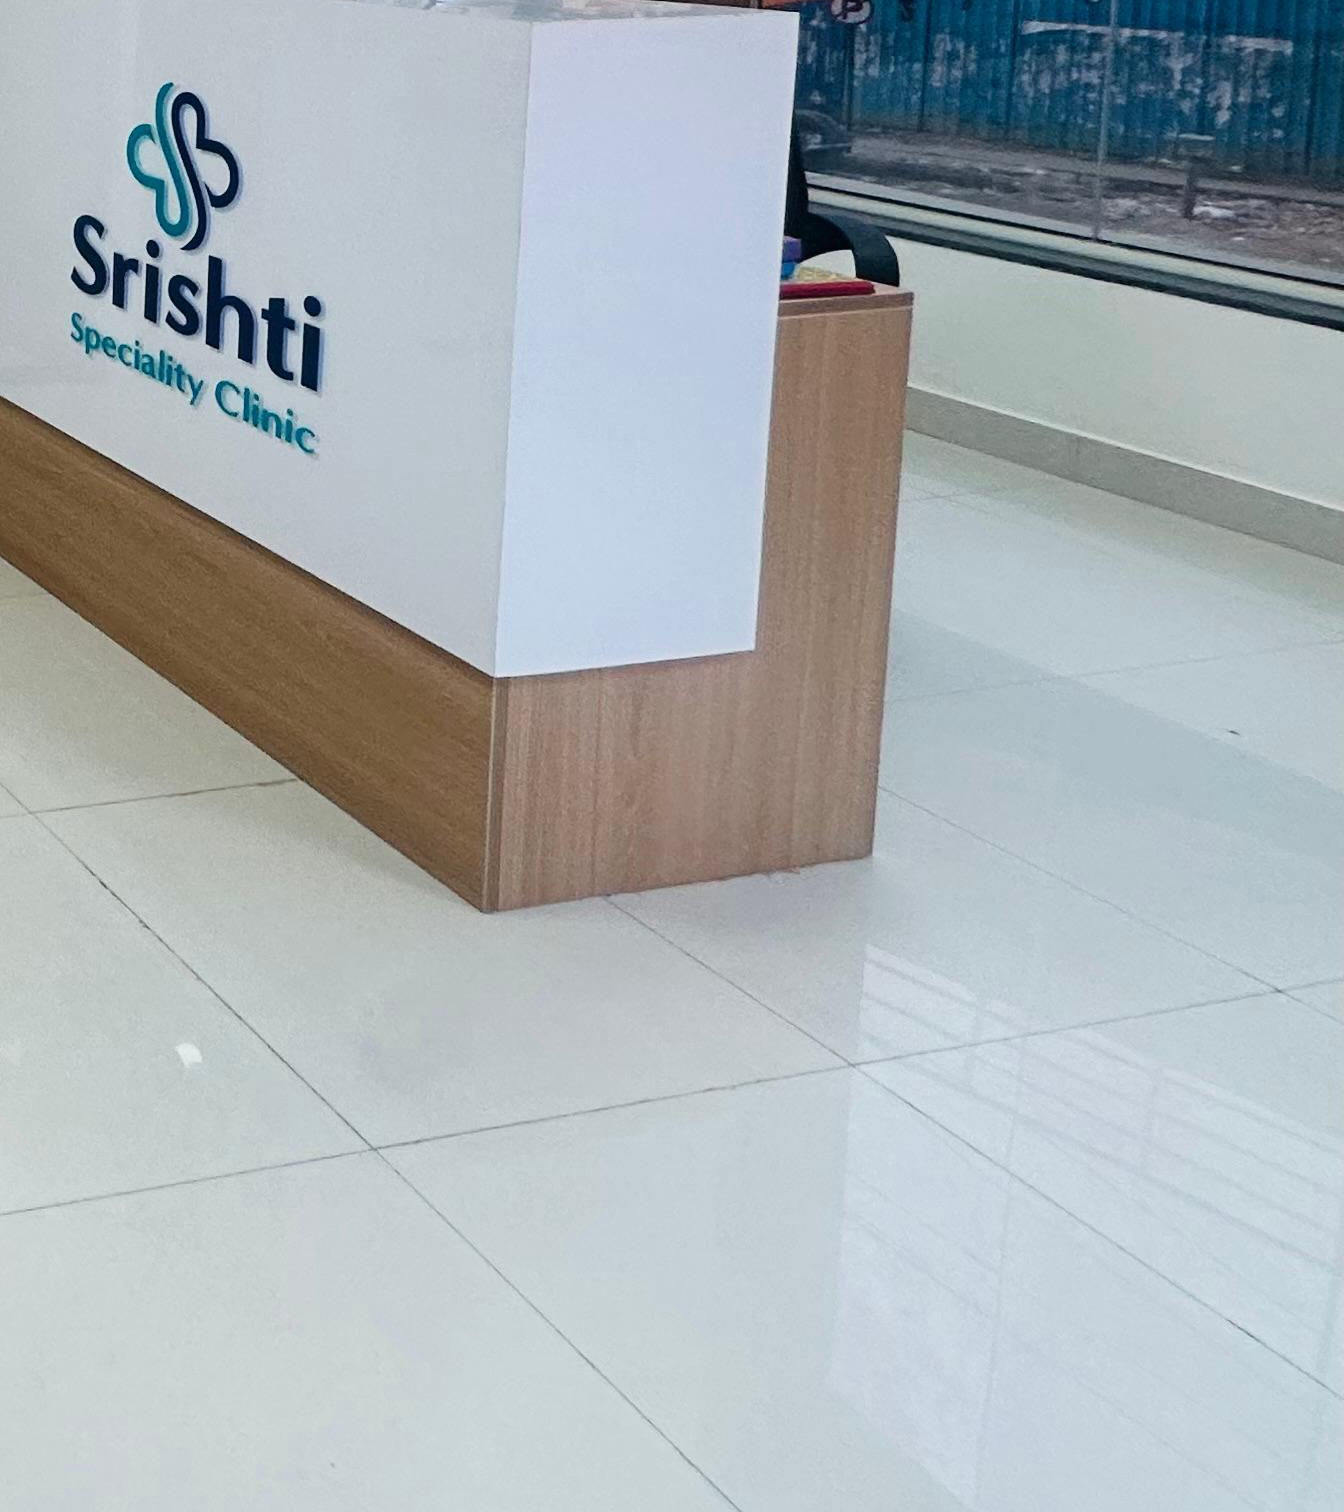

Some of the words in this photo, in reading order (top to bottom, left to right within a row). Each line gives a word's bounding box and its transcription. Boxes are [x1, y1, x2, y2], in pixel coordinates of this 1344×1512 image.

[71, 215, 322, 392] Srishti
[70, 312, 204, 406] Speciality
[214, 379, 318, 456] Clinic
